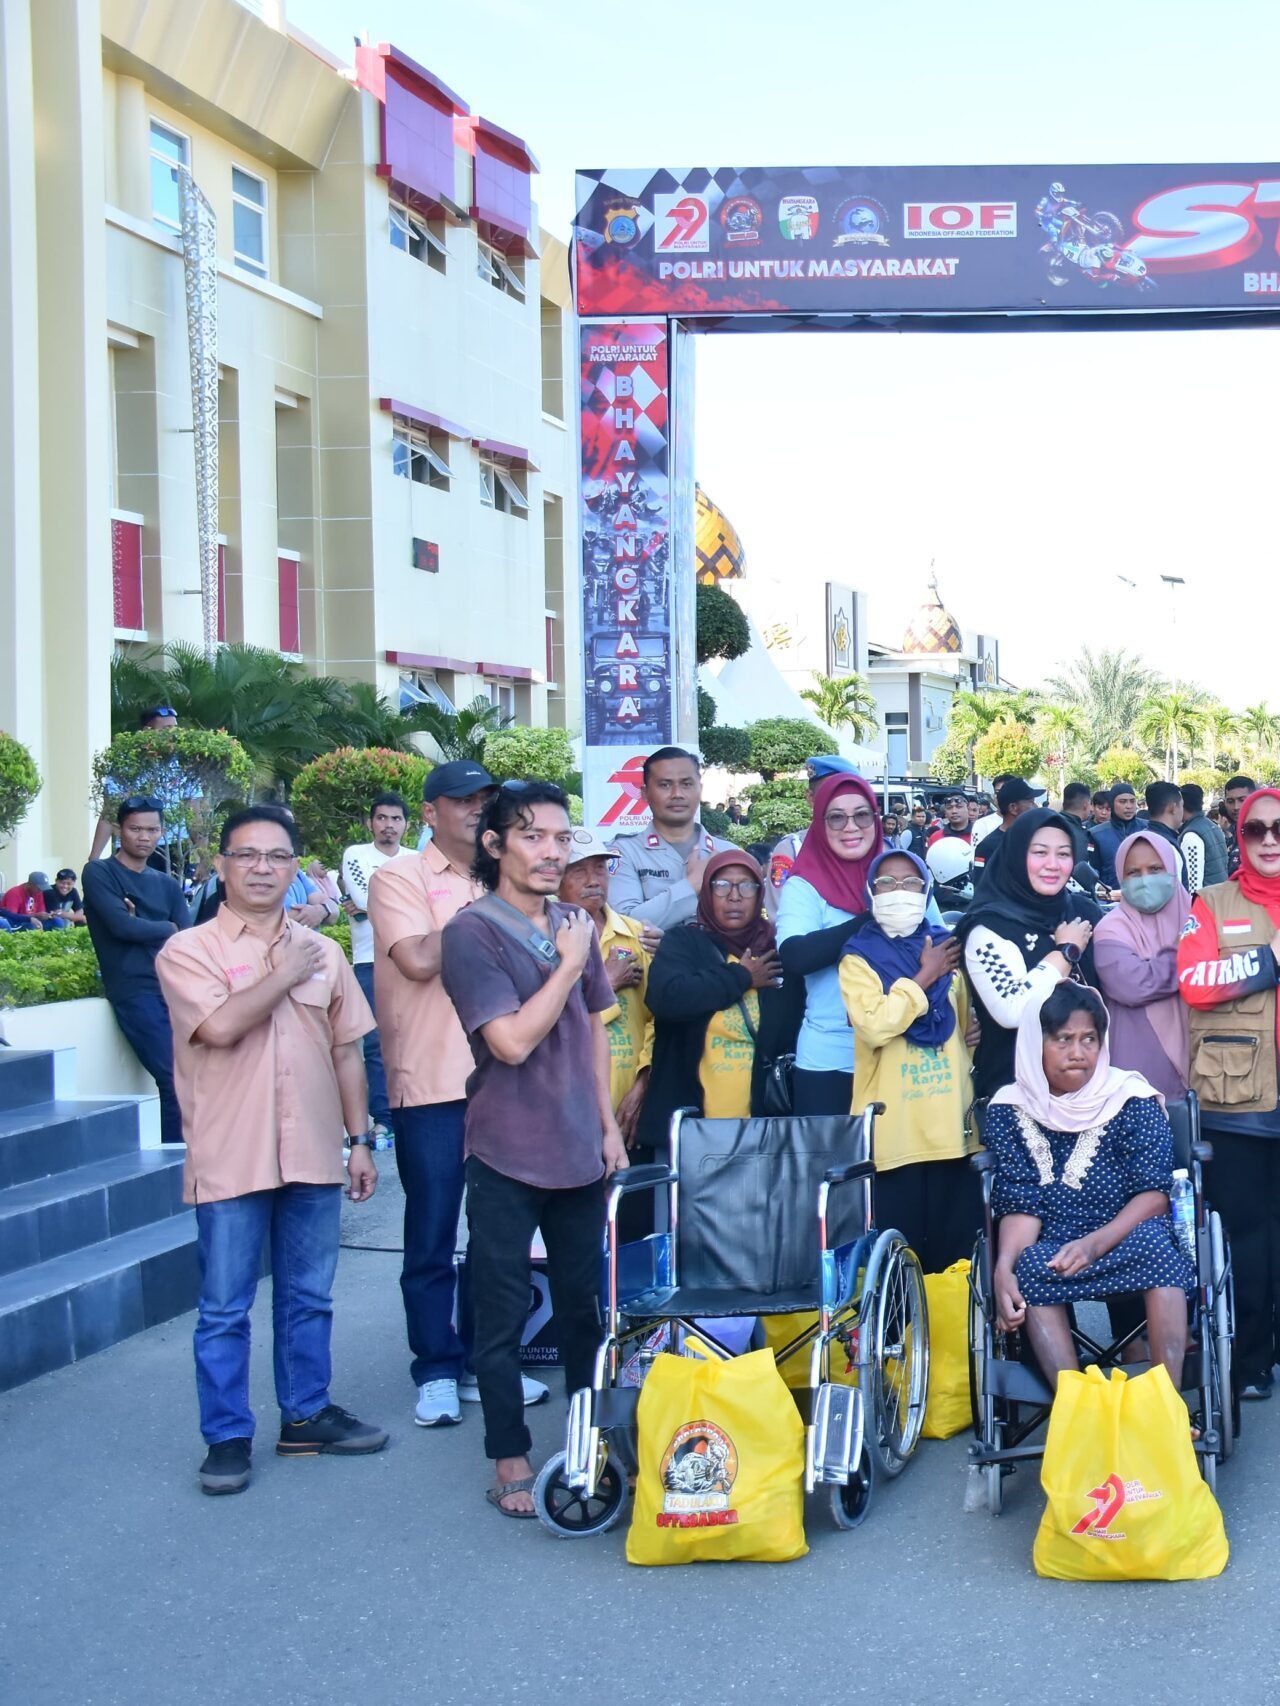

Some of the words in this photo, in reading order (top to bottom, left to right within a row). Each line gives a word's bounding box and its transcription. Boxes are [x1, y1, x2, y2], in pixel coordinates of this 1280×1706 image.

[907, 205, 1014, 230] IOF
[659, 261, 723, 280] POLRI
[728, 260, 804, 278] UNTUK
[808, 258, 959, 276] MASYARAKAT
[589, 353, 658, 362] MASYARAKAT
[591, 345, 620, 354] POLRI
[622, 345, 657, 353] UNTUK
[901, 1056, 949, 1078] Padat
[912, 1072, 952, 1085] Karya
